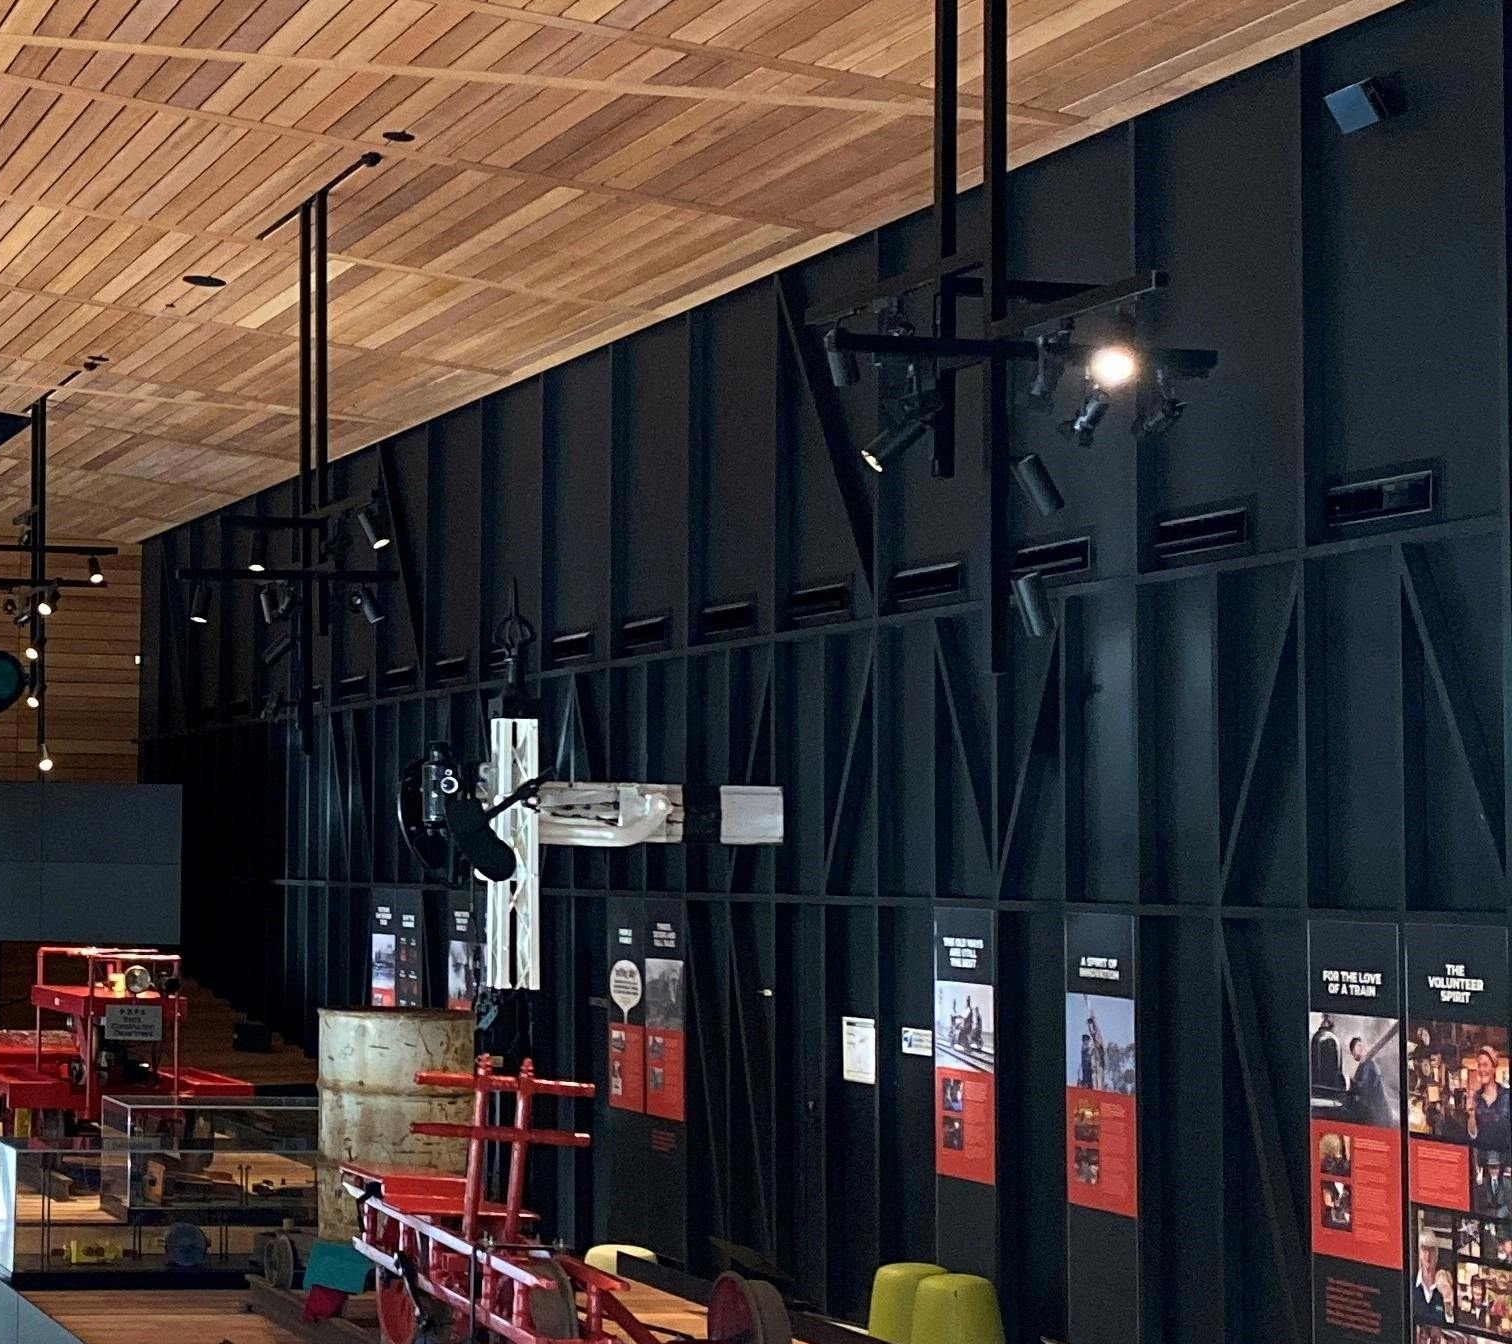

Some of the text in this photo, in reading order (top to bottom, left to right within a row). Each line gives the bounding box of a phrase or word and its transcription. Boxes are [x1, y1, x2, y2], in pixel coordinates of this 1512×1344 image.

[1445, 963, 1466, 977] THE
[1322, 970, 1382, 985] FOR THE LOVE
[1427, 975, 1484, 992] VOLUNTEER
[1327, 983, 1377, 997] OF A TRAIN
[1439, 990, 1472, 1004] SPIRIT
